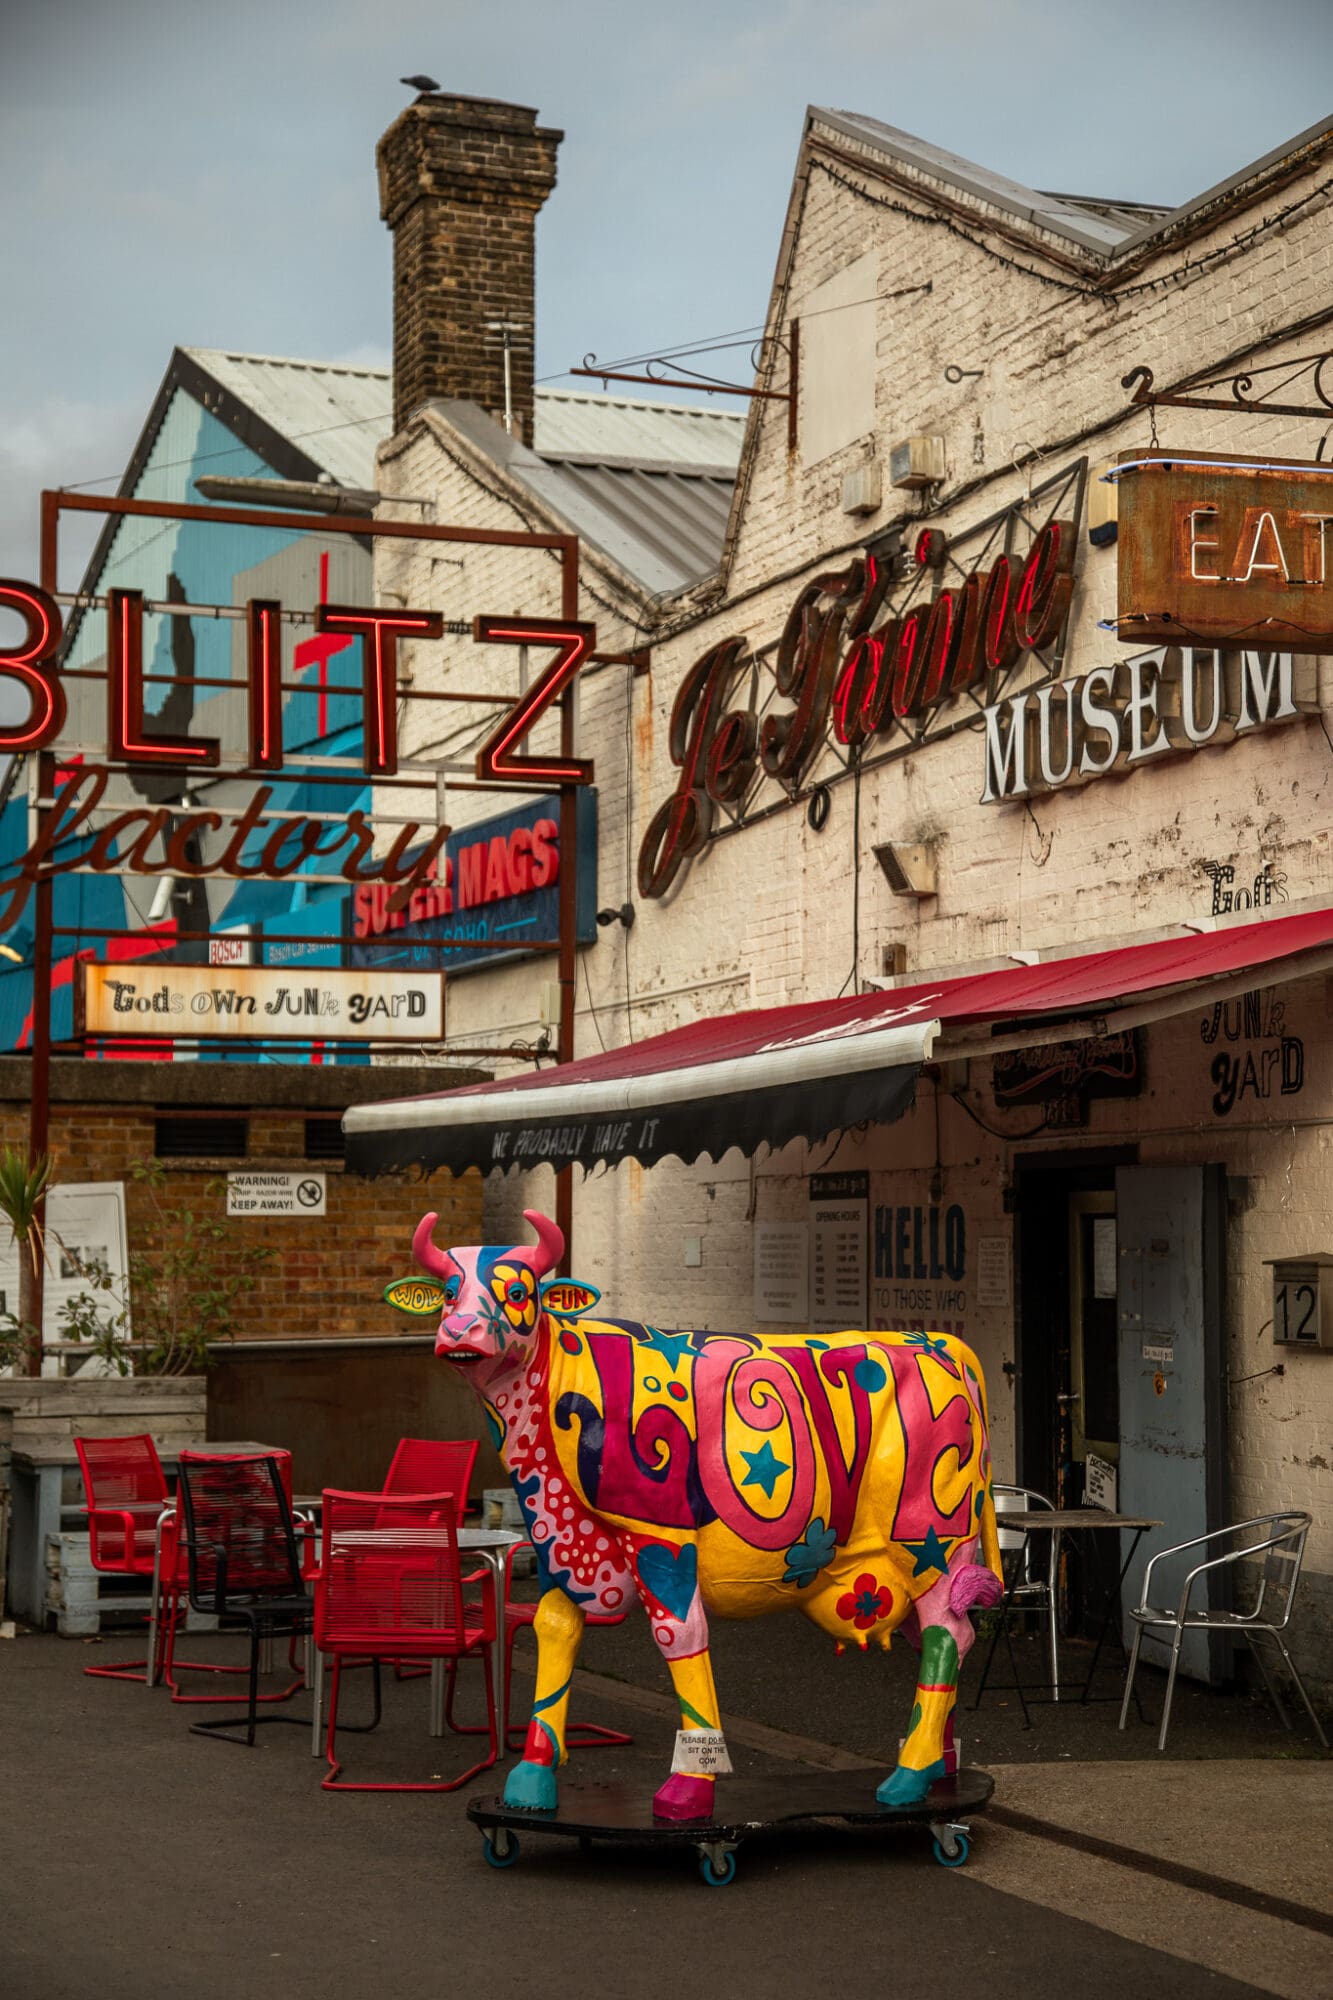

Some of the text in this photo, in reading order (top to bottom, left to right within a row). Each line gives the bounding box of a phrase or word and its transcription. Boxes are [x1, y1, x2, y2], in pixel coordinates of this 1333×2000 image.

[1186, 507, 1333, 585] EAT
[0, 578, 596, 785] BLITZ
[980, 647, 1298, 805] MUSEUM
[0, 765, 452, 930] factory
[458, 818, 560, 910] MAGS
[210, 939, 243, 966] BOSCH
[512, 1123, 587, 1156] PROBABLY
[592, 1121, 632, 1154] HAVE
[638, 1118, 660, 1150] IT
[235, 1176, 290, 1186] WARNING!
[231, 1200, 293, 1210] KEEP AWAY!
[875, 1204, 966, 1281] HELLO
[549, 1290, 588, 1310] FUN
[875, 1288, 966, 1312] TO THOSE WHO
[1276, 1285, 1317, 1340] 12
[584, 1333, 974, 1552] LOVE
[682, 1736, 706, 1744] PLEASE
[698, 1757, 717, 1765] COW
